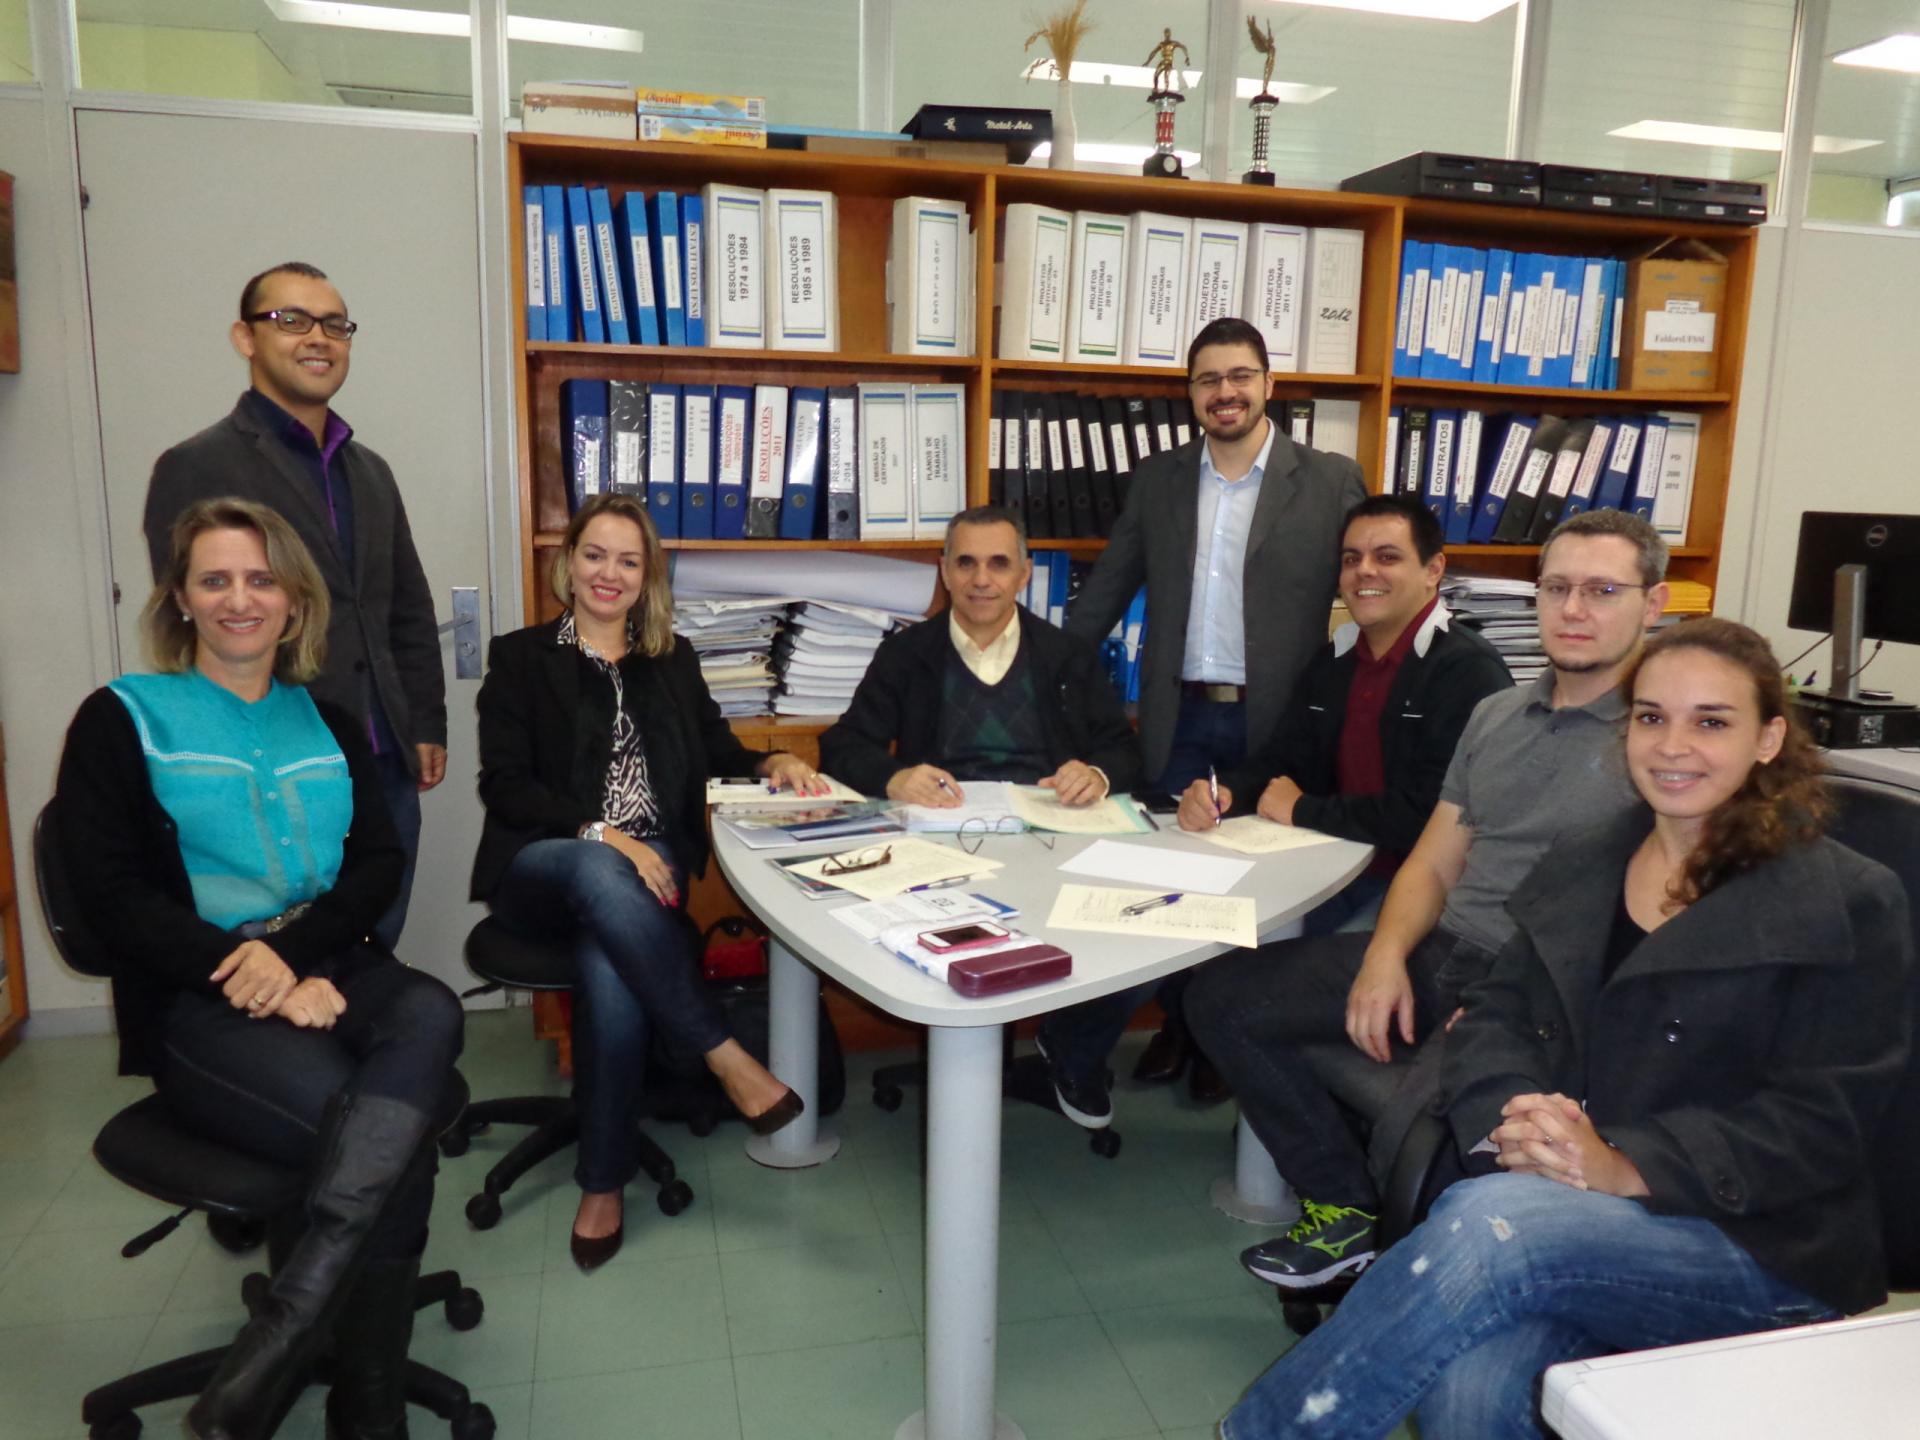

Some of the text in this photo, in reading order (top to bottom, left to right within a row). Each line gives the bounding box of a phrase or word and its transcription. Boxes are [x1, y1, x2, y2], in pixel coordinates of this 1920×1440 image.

[577, 227, 596, 310] REGIMENTOS PRA
[598, 225, 622, 320] REGIMENTOS PROPLAN
[728, 233, 737, 302] RESOLUÇÕES
[739, 235, 749, 261] 1984
[789, 235, 799, 304] RESOLUÇÕES
[802, 237, 811, 263] 1989
[739, 273, 749, 301] 1974
[803, 275, 812, 301] 1985
[1089, 269, 1098, 310] PROJETOS
[1096, 260, 1106, 321] INSTITUCIONAIS
[1149, 274, 1158, 316] PROJETOS
[1156, 266, 1166, 326] INSTITUCIONAIS
[1200, 272, 1211, 322] PROJETOS
[1265, 268, 1276, 318] PROJETOS
[1273, 257, 1285, 330] INSTITUCIONAIS
[1282, 293, 1292, 313] 2011
[1320, 307, 1353, 322] 2012
[724, 414, 733, 469] RESOLUÇÕES
[759, 405, 770, 483] RESOLUÇÕES
[773, 435, 783, 457] 2011
[831, 416, 841, 482] RESOLUÇÕES
[873, 439, 879, 450] DE
[880, 436, 888, 485] CERTIFICADOS
[925, 436, 932, 447] DE
[934, 437, 942, 479] TRABALHO
[1434, 423, 1449, 493] CONTRATOS
[1491, 425, 1520, 494] GABINETE DO REITOR
[843, 461, 852, 483] 2014
